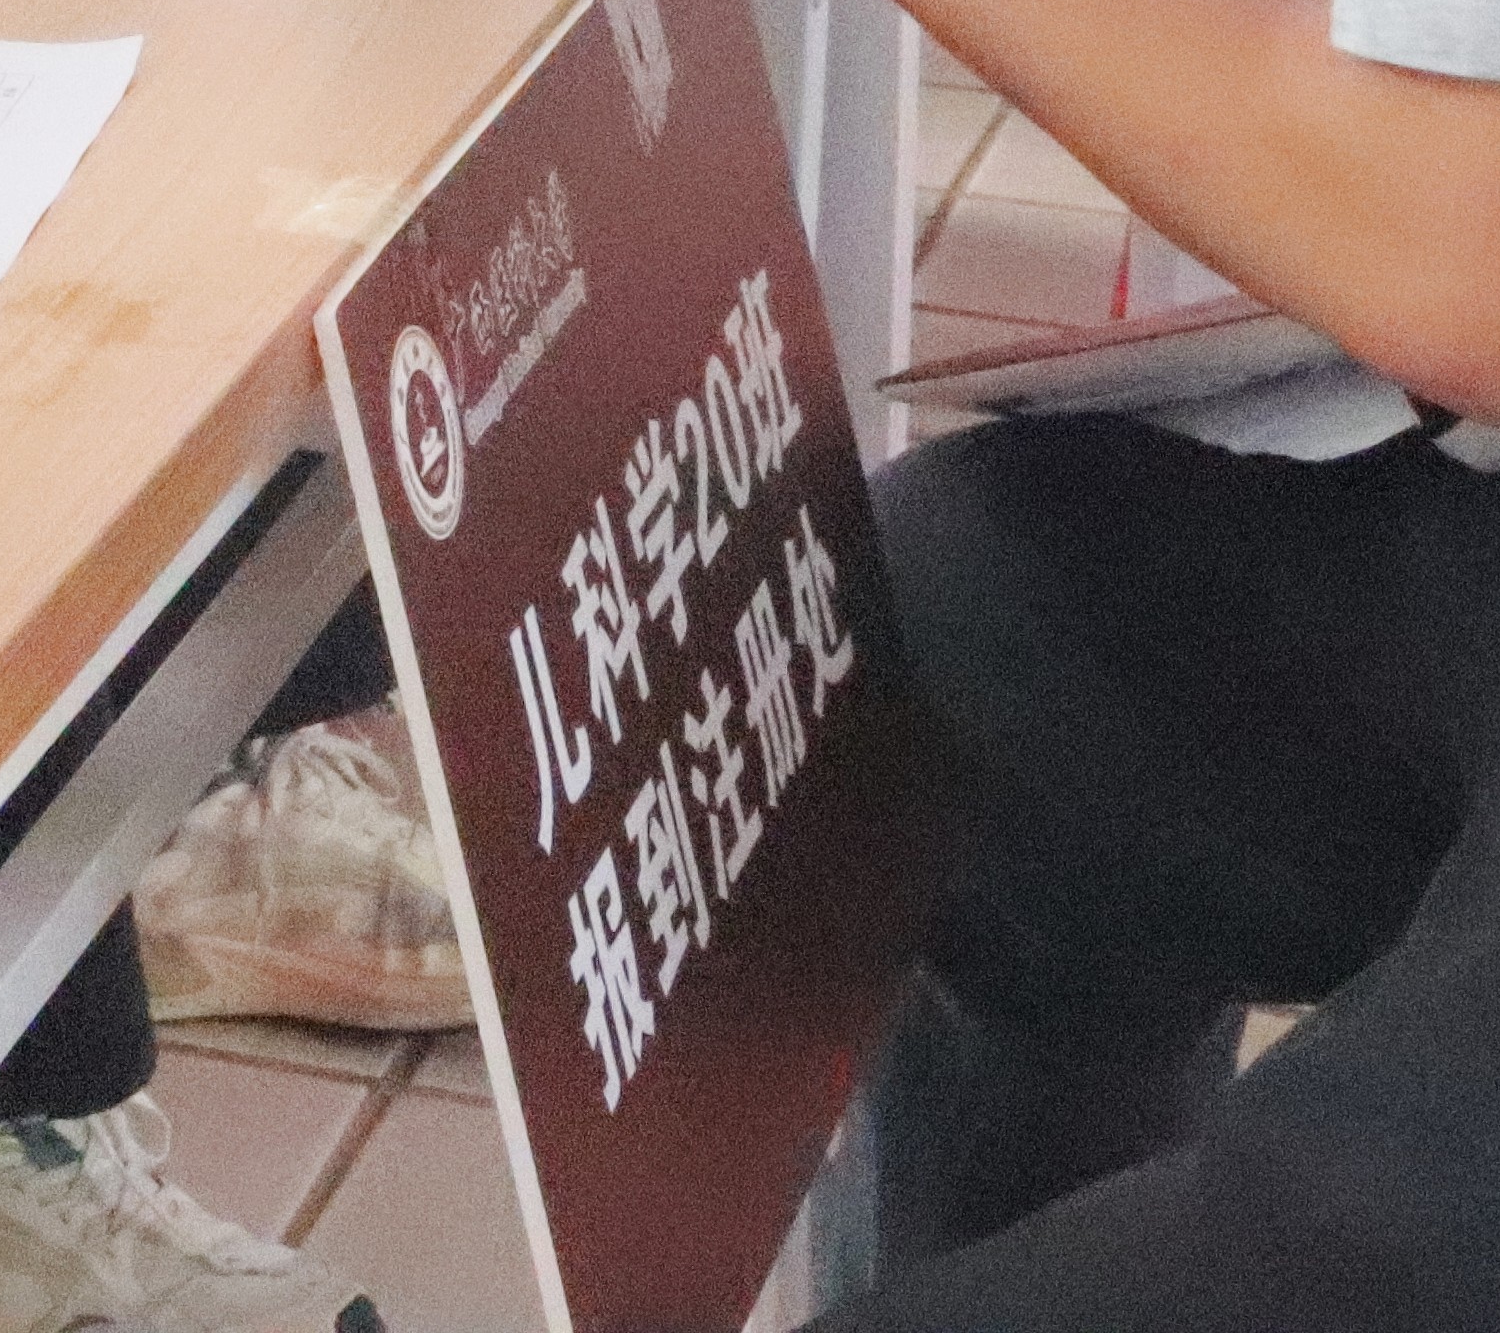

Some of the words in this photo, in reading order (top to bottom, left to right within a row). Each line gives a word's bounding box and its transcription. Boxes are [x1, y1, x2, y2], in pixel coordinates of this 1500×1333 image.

[510, 268, 802, 857] 儿科学20班
[568, 504, 855, 1116] 报到注册处
